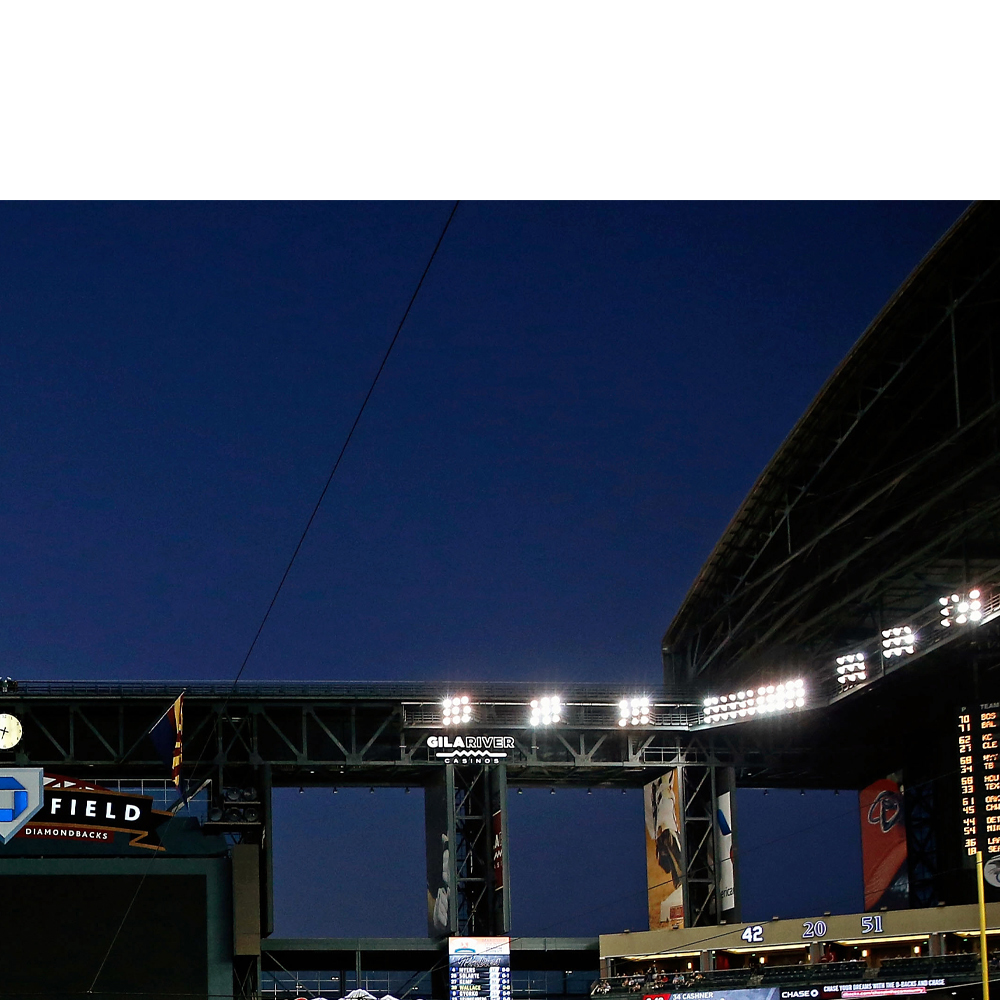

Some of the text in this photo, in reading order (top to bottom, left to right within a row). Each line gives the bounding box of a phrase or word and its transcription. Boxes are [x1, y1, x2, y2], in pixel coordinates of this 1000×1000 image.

[959, 712, 996, 723] 70 BOS
[958, 723, 970, 732] 71
[959, 736, 971, 744] 62
[51, 798, 141, 821] FIELD
[25, 828, 108, 840] DIAMONDBACKS
[802, 920, 827, 938] 20
[861, 916, 883, 934] 51
[741, 926, 764, 942] 42
[682, 992, 713, 1000] CASHNER
[781, 990, 810, 998] CHASE
